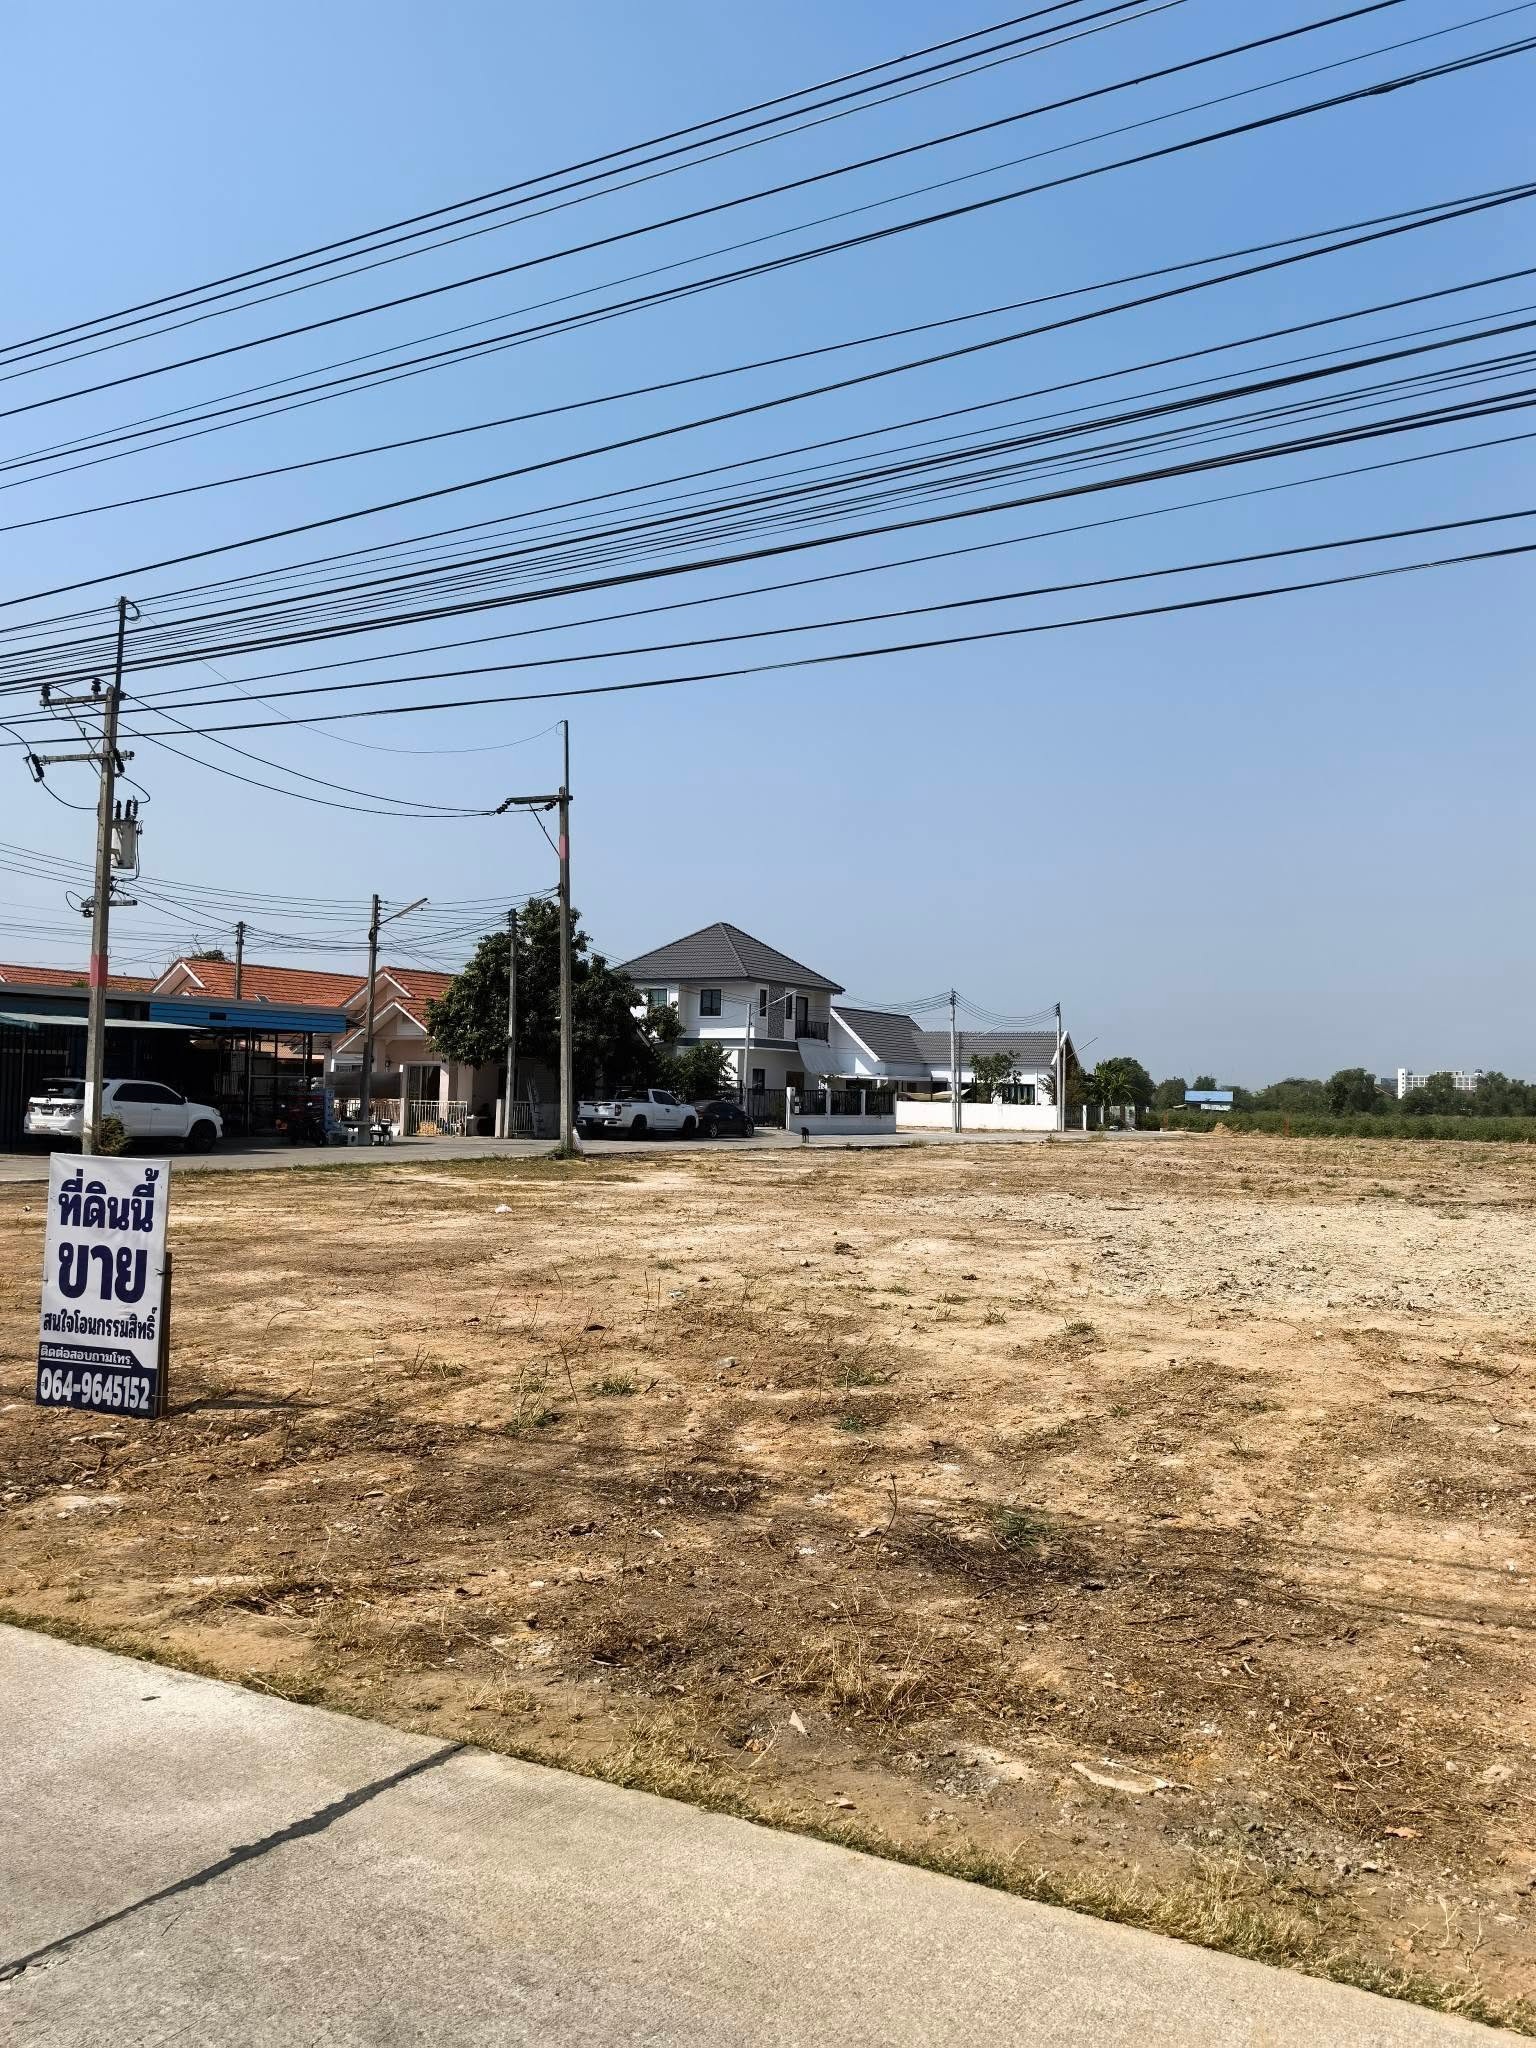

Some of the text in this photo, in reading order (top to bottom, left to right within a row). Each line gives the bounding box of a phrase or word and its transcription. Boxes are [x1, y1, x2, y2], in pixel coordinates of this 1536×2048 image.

[58, 1167, 159, 1233] ที่ดินนี้
[58, 1242, 148, 1304] ขาย
[40, 1367, 150, 1410] 064-9645152
